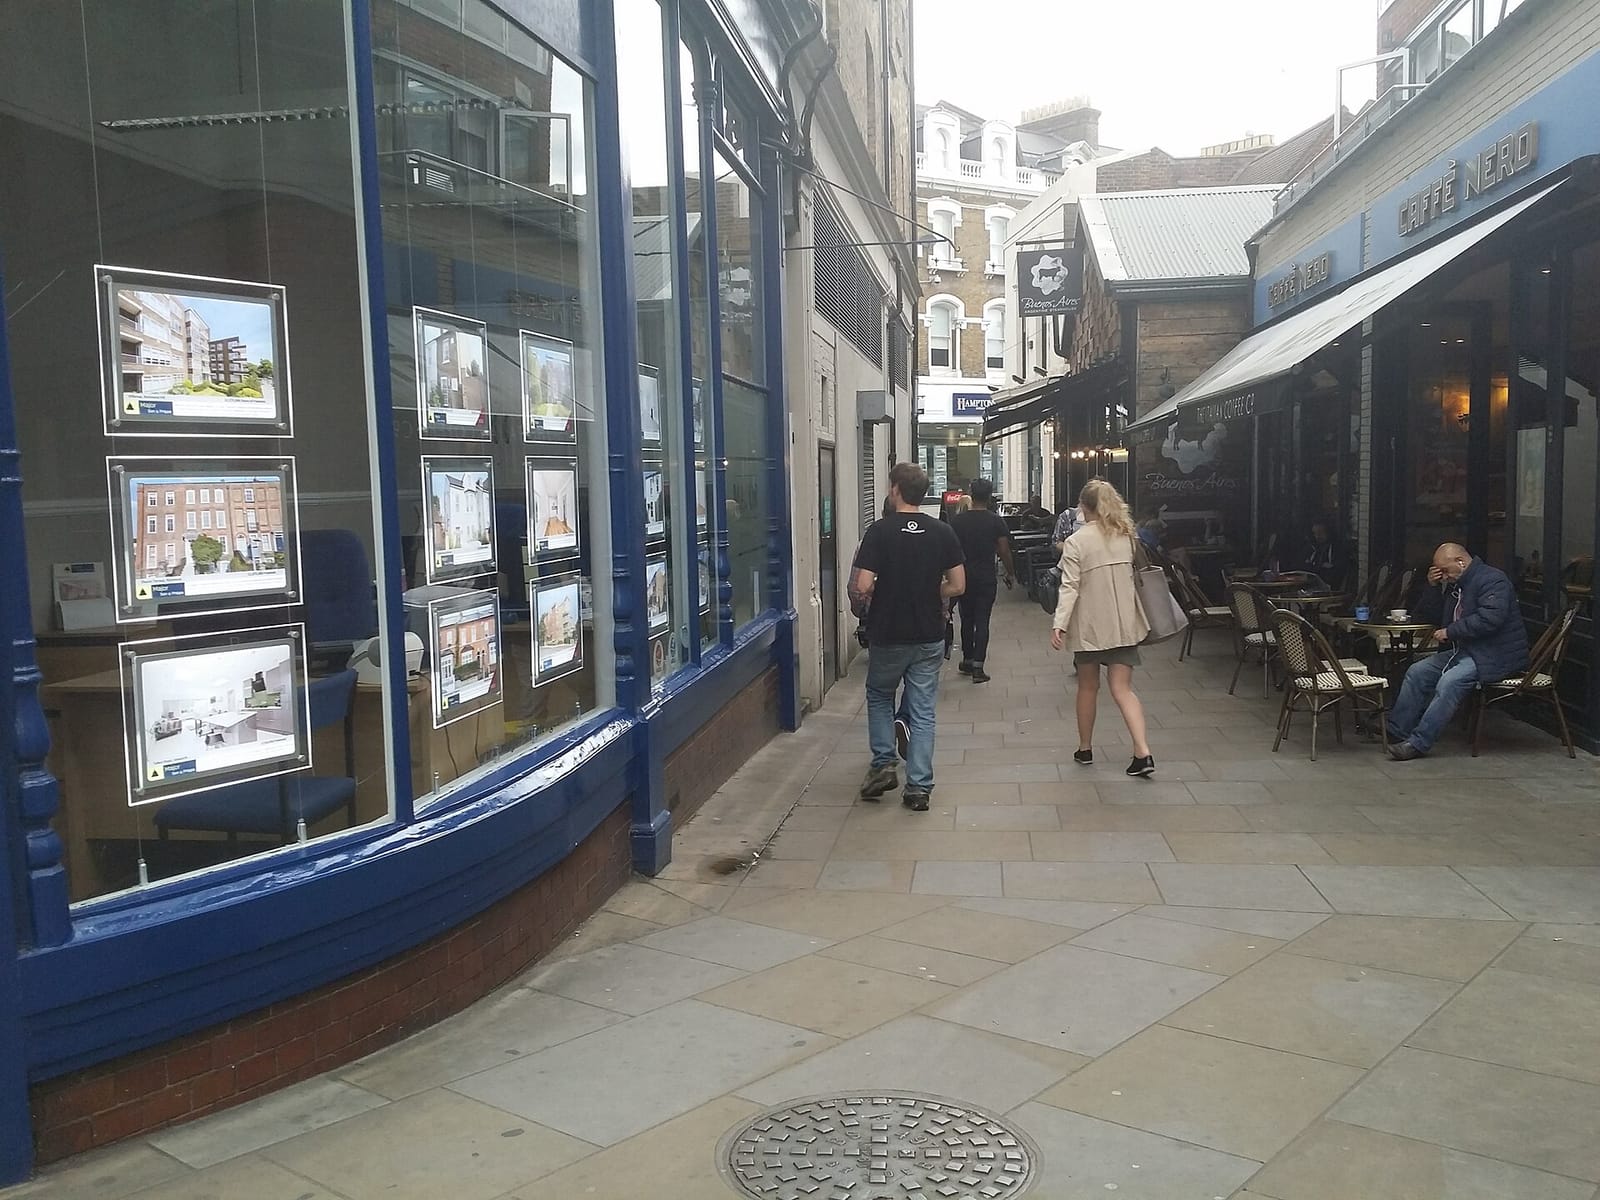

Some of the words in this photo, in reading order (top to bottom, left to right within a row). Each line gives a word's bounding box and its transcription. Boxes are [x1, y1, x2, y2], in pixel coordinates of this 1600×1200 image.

[1398, 159, 1457, 237] CAFFÈ
[1464, 122, 1538, 201] NERO
[1268, 263, 1297, 310] CAFFÈ
[1298, 252, 1330, 294] NERO
[1021, 297, 1055, 310] Buenos
[1053, 295, 1081, 308] Aires
[1145, 473, 1195, 491] Buenos
